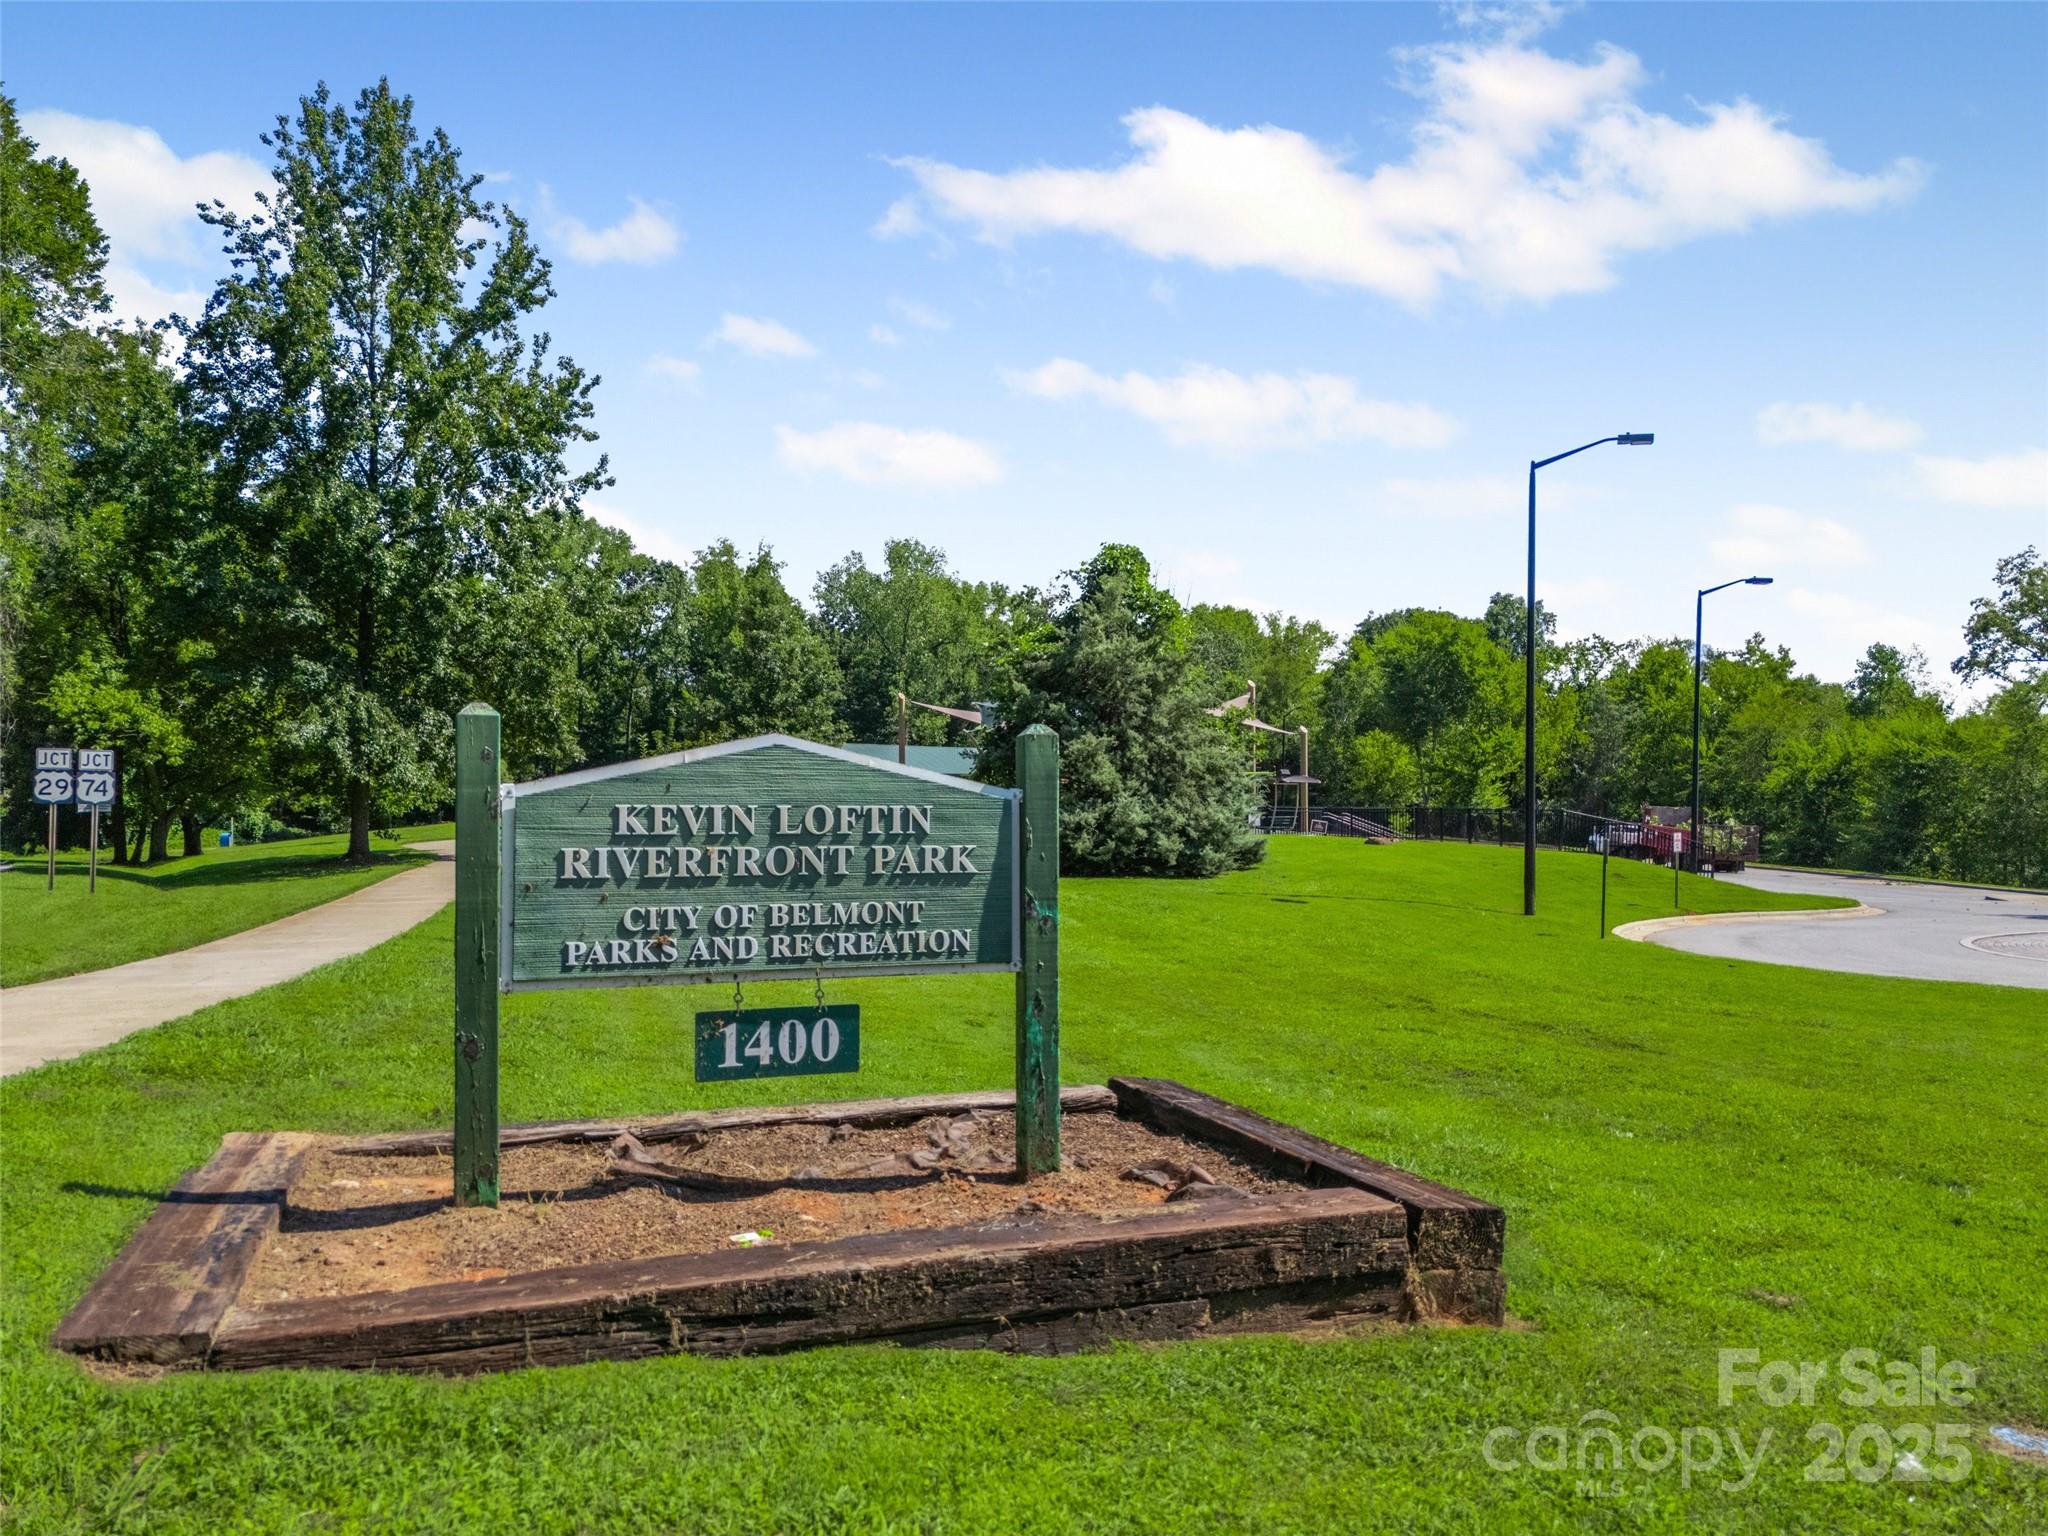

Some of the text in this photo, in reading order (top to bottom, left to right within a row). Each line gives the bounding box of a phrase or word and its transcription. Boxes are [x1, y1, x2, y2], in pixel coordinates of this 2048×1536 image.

[39, 752, 68, 765] JCT
[82, 754, 111, 766] JCT
[38, 778, 68, 795] 29
[82, 779, 108, 796] 74
[614, 803, 933, 837] KEVIN LOFTIN
[560, 844, 980, 880] RIVERFRONT PARK
[622, 900, 926, 933] CITY OF BELMONT
[565, 928, 972, 967] PARKS AND RECREATION
[716, 1016, 840, 1069] 1400
